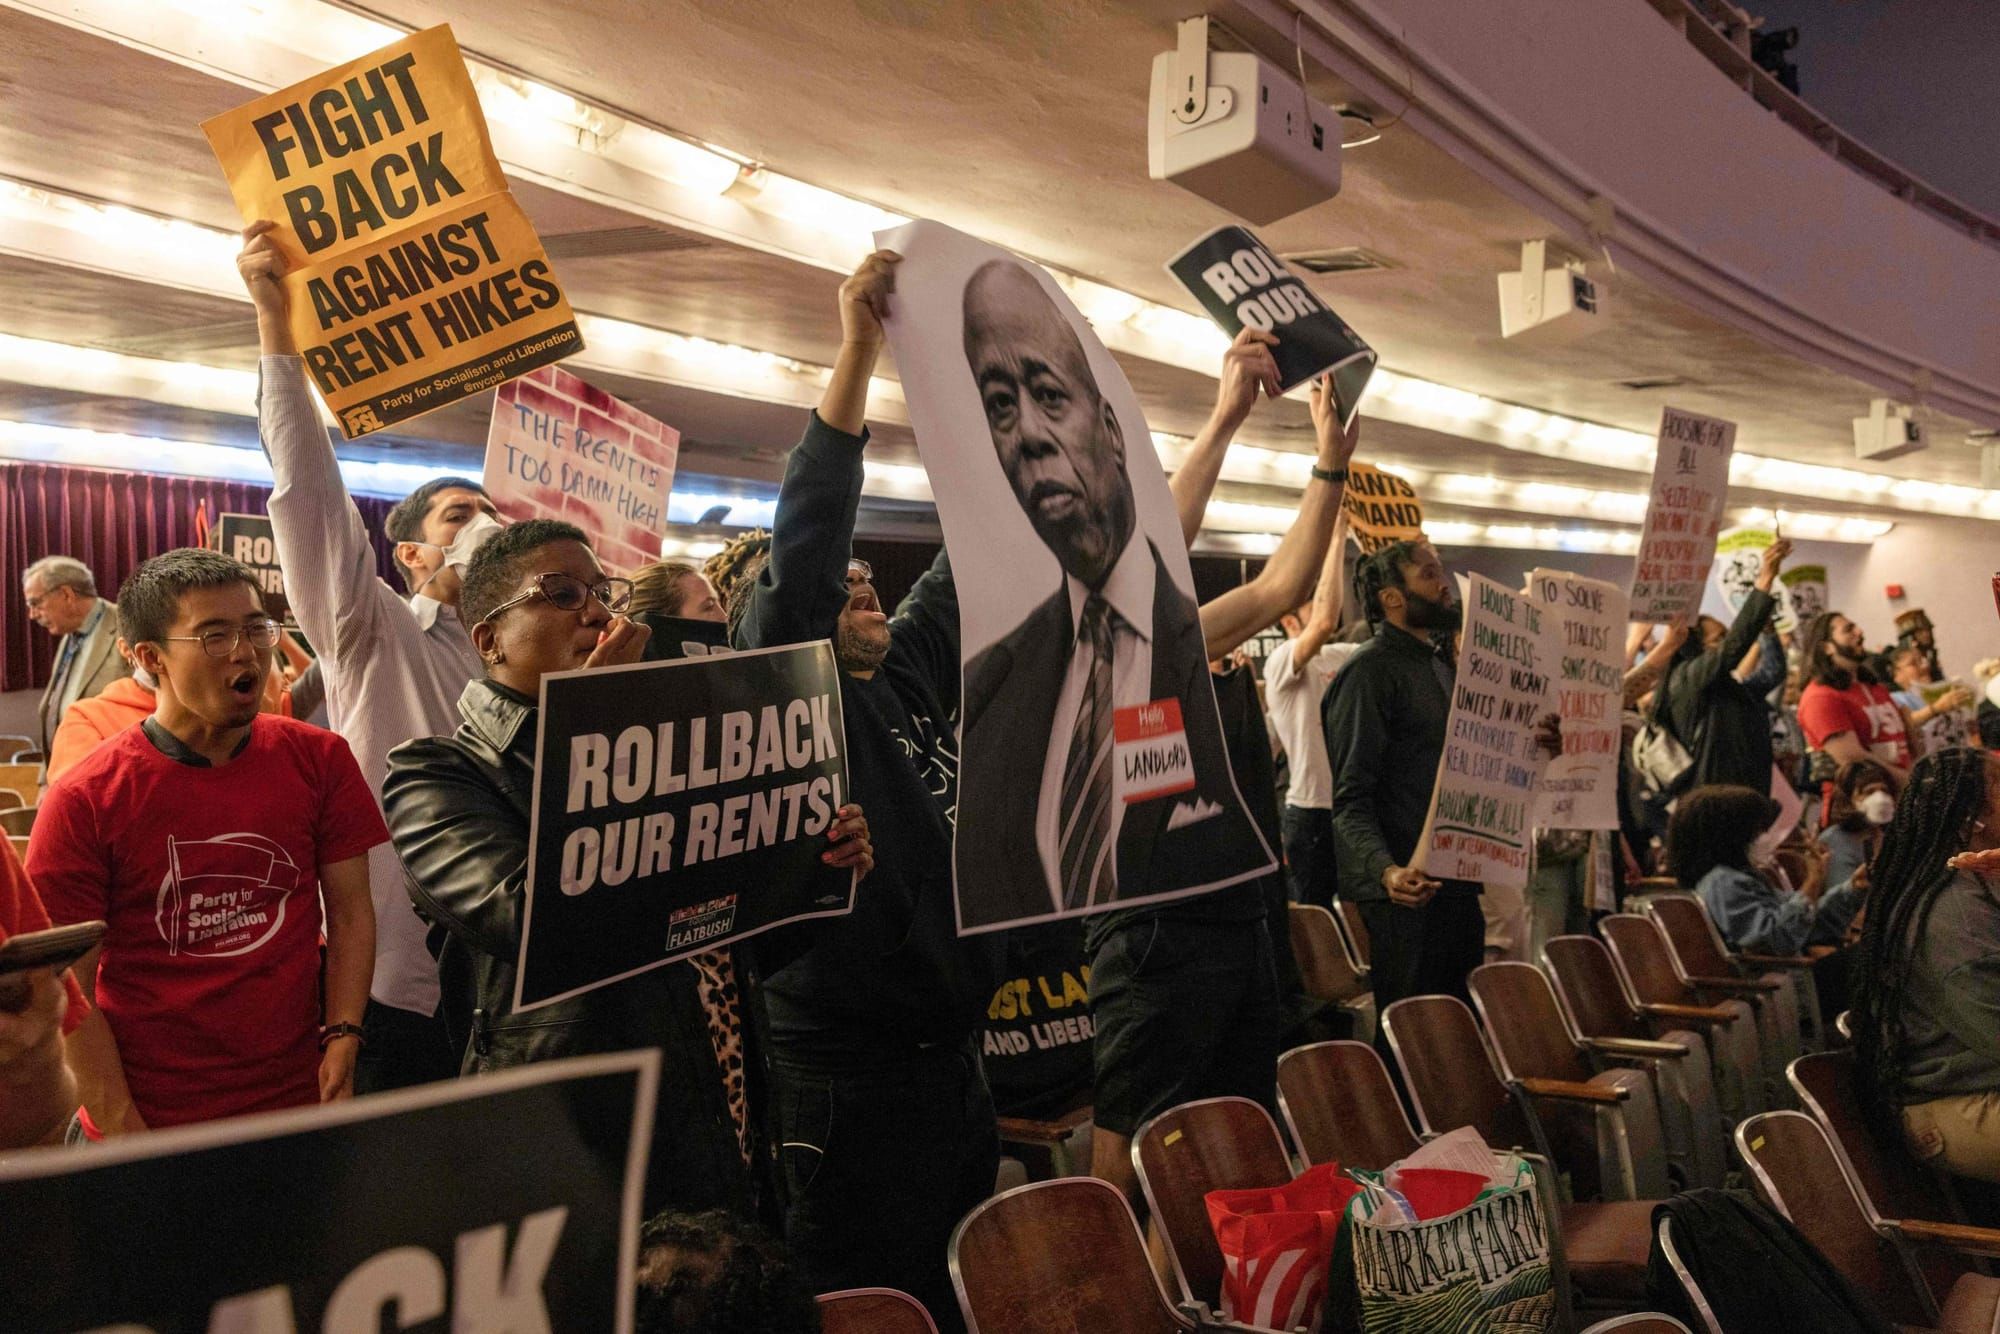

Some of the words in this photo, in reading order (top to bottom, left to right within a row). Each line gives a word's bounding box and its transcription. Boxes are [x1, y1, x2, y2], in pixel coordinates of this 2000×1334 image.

[252, 53, 429, 181] FIGHT
[283, 131, 465, 255] BACK
[306, 211, 501, 331] AGAINST
[303, 316, 426, 396] RENT
[424, 259, 561, 350] HIKES
[1236, 283, 1320, 334] OUR
[381, 391, 415, 411] Party
[414, 380, 432, 398] for
[433, 361, 491, 389] Socialism
[492, 352, 517, 369] and
[516, 328, 576, 359] Liberation
[463, 370, 506, 394] @nycpsl
[350, 410, 385, 437] PSL
[513, 402, 566, 449] THE
[575, 428, 638, 482] RENT
[504, 443, 552, 486] TOO
[561, 462, 615, 503] DAMN
[617, 484, 660, 531] HIGH
[1345, 471, 1416, 498] ANTS
[1480, 582, 1515, 625] HOUSE
[1523, 602, 1542, 635] THE
[1536, 576, 1558, 603] TO
[1565, 579, 1605, 614] SOLVE
[1457, 684, 1496, 720] UNITS
[1499, 699, 1514, 722] IN
[1514, 701, 1539, 730] NYC
[1510, 667, 1550, 697] VACANT
[566, 694, 838, 814] ROLLBACK
[1124, 742, 1187, 782] LANDLORD
[559, 809, 675, 897] OUR
[683, 773, 841, 867] RENTS!
[189, 891, 238, 911] Party
[241, 888, 254, 902] for
[670, 918, 730, 948] FLATBUSH
[983, 1030, 1031, 1056] AND
[1353, 1213, 1469, 1296] MARKET
